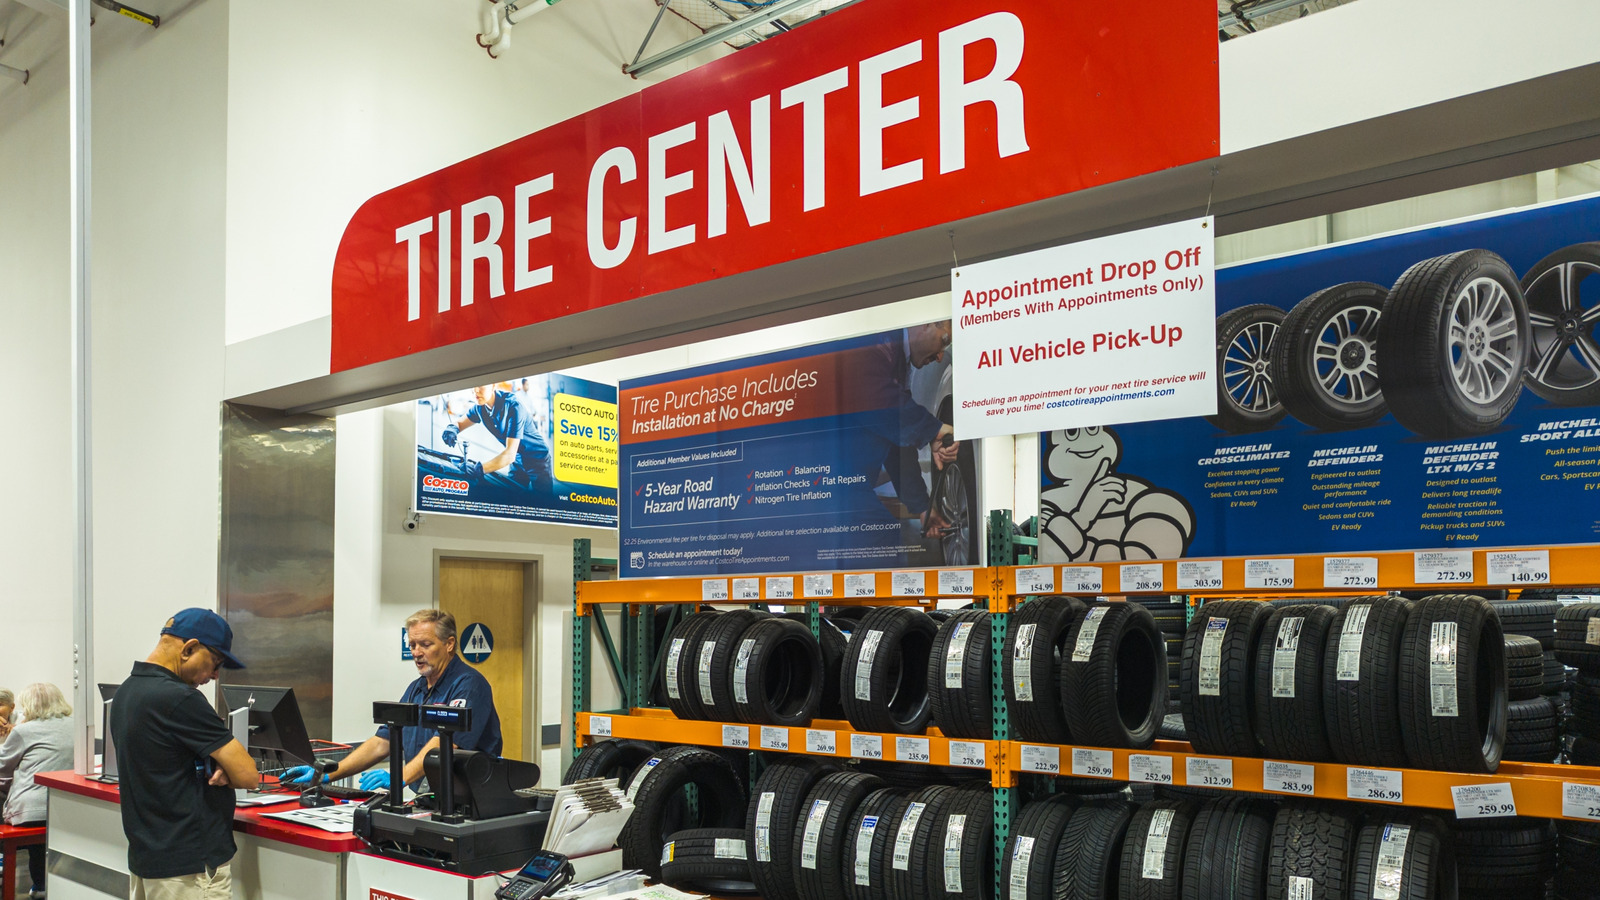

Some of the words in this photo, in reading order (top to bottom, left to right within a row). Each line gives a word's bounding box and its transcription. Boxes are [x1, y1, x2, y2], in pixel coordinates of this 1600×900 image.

[395, 173, 554, 322] TIRE
[586, 11, 1030, 270] CENTER
[962, 269, 1093, 308] Appointment
[1102, 260, 1156, 281] Drop
[1165, 247, 1201, 270] Off
[960, 309, 1020, 328] (Members
[1025, 301, 1053, 314] With
[1058, 285, 1157, 310] Appointments
[1163, 275, 1203, 292] Only)
[978, 349, 1002, 368] All
[1010, 339, 1085, 363] Vehicle
[1093, 325, 1182, 351] Pick-Up
[631, 396, 659, 415] Tire
[664, 386, 737, 410] Purchase
[742, 370, 818, 396] Includes
[962, 398, 1005, 408] Scheduling
[1019, 389, 1072, 404] appointment
[1075, 387, 1086, 396] for
[1089, 385, 1109, 394] your
[1112, 382, 1131, 391] next
[1134, 379, 1149, 387] tire
[1152, 375, 1186, 385] service
[1189, 372, 1206, 380] will
[1007, 406, 1021, 415] you
[1024, 402, 1044, 411] time!
[1047, 389, 1174, 408] costcotireappointments.com
[560, 403, 592, 415] COSTCO
[594, 410, 614, 420] AUTO
[632, 413, 700, 433] Installation
[703, 409, 716, 423] at
[719, 405, 738, 420] No
[742, 399, 796, 417] Charge
[561, 420, 593, 438] Save
[598, 426, 619, 444] 15%
[1520, 431, 1571, 442] SPORT
[1215, 444, 1272, 454] MICHELIN
[1313, 446, 1377, 457] MICHELIN
[1425, 442, 1497, 454] MICHELIN
[637, 458, 666, 467] Additional
[711, 448, 737, 458] Included
[1198, 451, 1290, 465] CROSSCLIMATE2
[1308, 454, 1383, 466] DEFENDER2
[1423, 452, 1499, 464] DEFENDER
[795, 465, 830, 474] Balancing
[1427, 465, 1452, 473] LTX
[1454, 462, 1484, 472] M/S
[755, 470, 783, 478] Rotation
[1311, 472, 1347, 480] Engineered
[424, 476, 468, 490] COSTCO
[838, 475, 866, 484] Repairs
[645, 483, 681, 496] 5-Year
[684, 477, 713, 493] Road
[755, 483, 782, 491] Inflation
[784, 480, 810, 488] Checks
[755, 496, 784, 504] Nitrogen
[801, 491, 831, 500] Inflation
[644, 498, 684, 513] Hazard
[688, 494, 740, 509] Warranty
[684, 550, 722, 558] appointment
[723, 547, 743, 558] today!
[1344, 577, 1376, 585] 272.99
[1437, 572, 1471, 580] 272.99
[1512, 572, 1548, 582] 140.99
[1136, 582, 1162, 590] 208.99
[1264, 578, 1292, 586] 175.99
[814, 588, 832, 596] 161.99
[904, 586, 924, 595] 286.99
[951, 586, 972, 594] 303.99
[1030, 584, 1053, 592] 154.99
[770, 741, 788, 749] 255.99
[817, 744, 836, 752] 269.99
[861, 750, 882, 758] 176.99
[908, 752, 929, 761] 235.99
[963, 758, 984, 766] 278.99
[1035, 762, 1058, 771] 222.99
[1088, 766, 1112, 775] 259.99
[1145, 773, 1171, 782] 252.99
[1204, 776, 1232, 786] 312.99
[1282, 782, 1312, 792] 283.99
[1368, 789, 1401, 799] 286.99
[1478, 804, 1514, 814] 259.99
